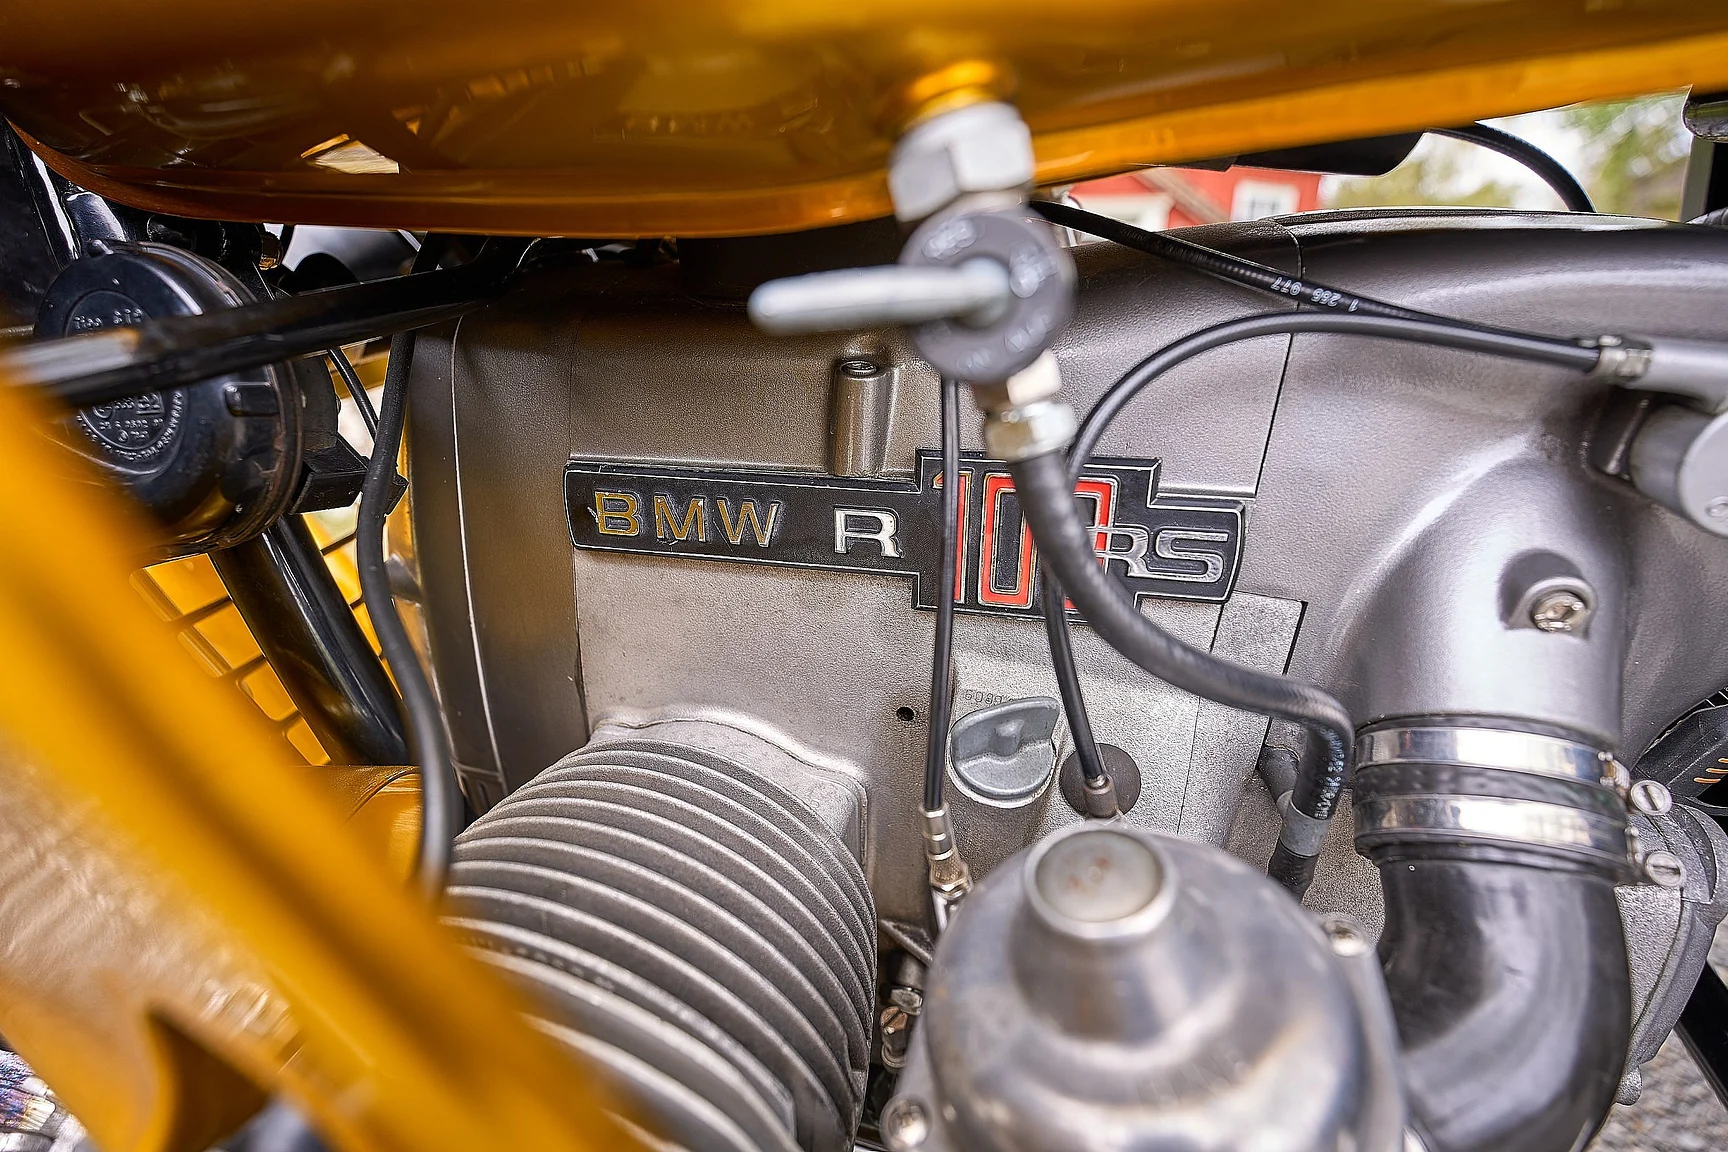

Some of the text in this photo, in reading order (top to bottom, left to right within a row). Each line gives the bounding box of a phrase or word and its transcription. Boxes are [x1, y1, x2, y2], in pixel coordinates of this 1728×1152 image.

[1271, 276, 1302, 296] 977
[593, 489, 784, 548] BMW
[832, 504, 905, 559] R
